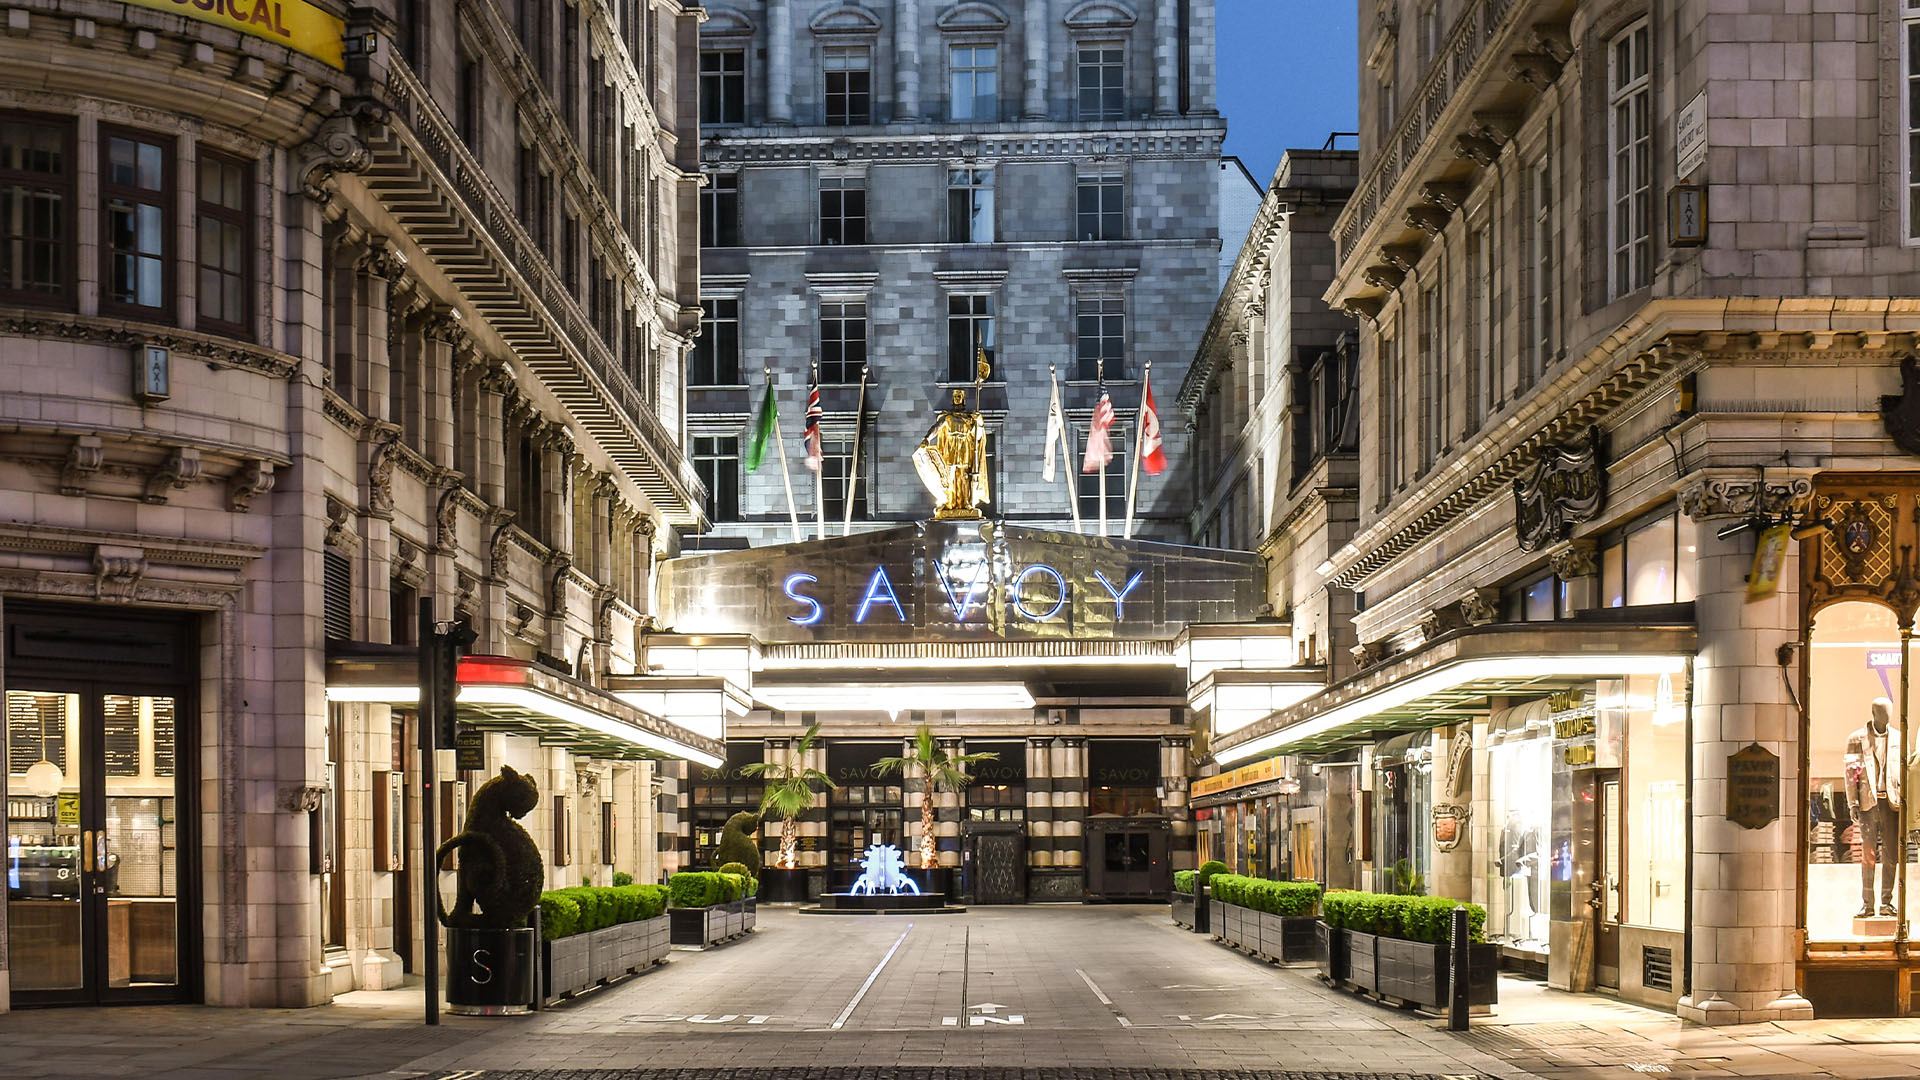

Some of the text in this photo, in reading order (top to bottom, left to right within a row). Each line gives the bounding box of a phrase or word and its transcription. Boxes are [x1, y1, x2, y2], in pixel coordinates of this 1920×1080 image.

[1684, 192, 1694, 235] TAXI
[152, 351, 160, 392] TAXI
[783, 559, 1144, 625] SAVOY
[1099, 768, 1150, 781] SAVOY
[471, 949, 492, 985] S
[619, 1013, 784, 1024] OUT
[941, 1014, 1024, 1026] IN
